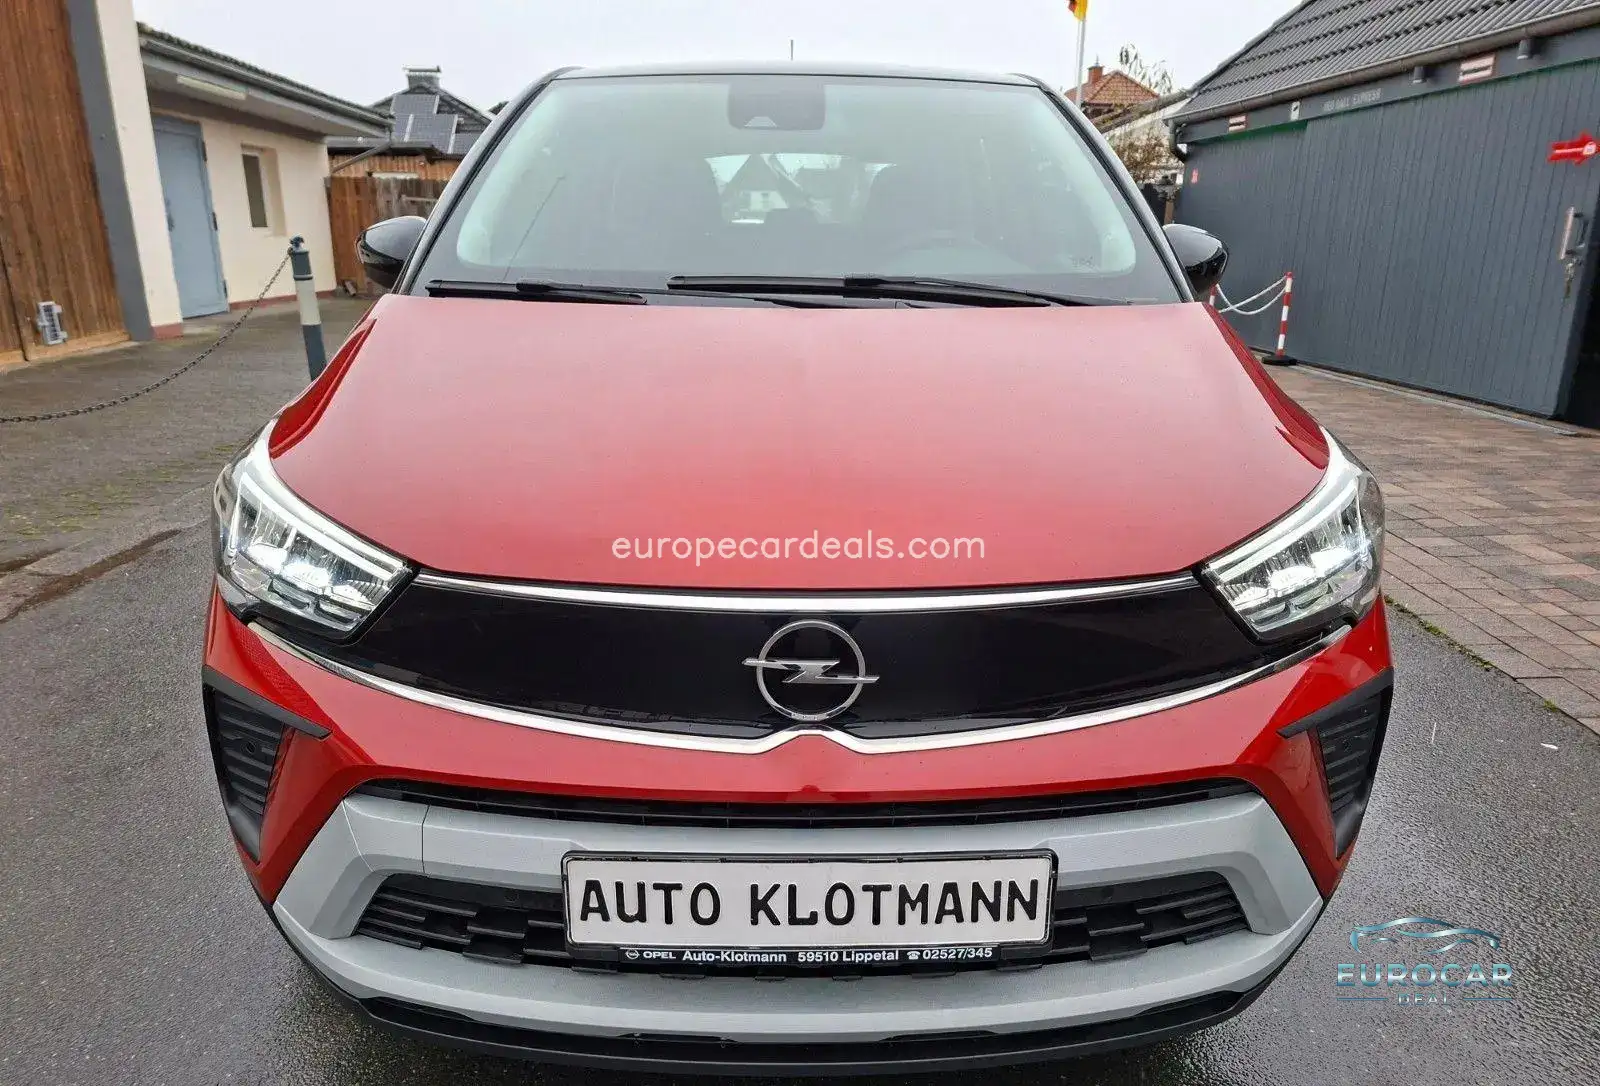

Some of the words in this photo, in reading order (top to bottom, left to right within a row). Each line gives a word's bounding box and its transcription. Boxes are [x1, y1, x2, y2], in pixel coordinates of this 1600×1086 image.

[580, 879, 721, 926] AUTO
[750, 878, 1039, 926] KLOTMANN
[643, 951, 677, 959] OPEL
[682, 950, 787, 963] Auto-Klotmann
[797, 951, 839, 962] 59510
[842, 949, 899, 963] Lippetal
[922, 947, 993, 960] 02527/345
